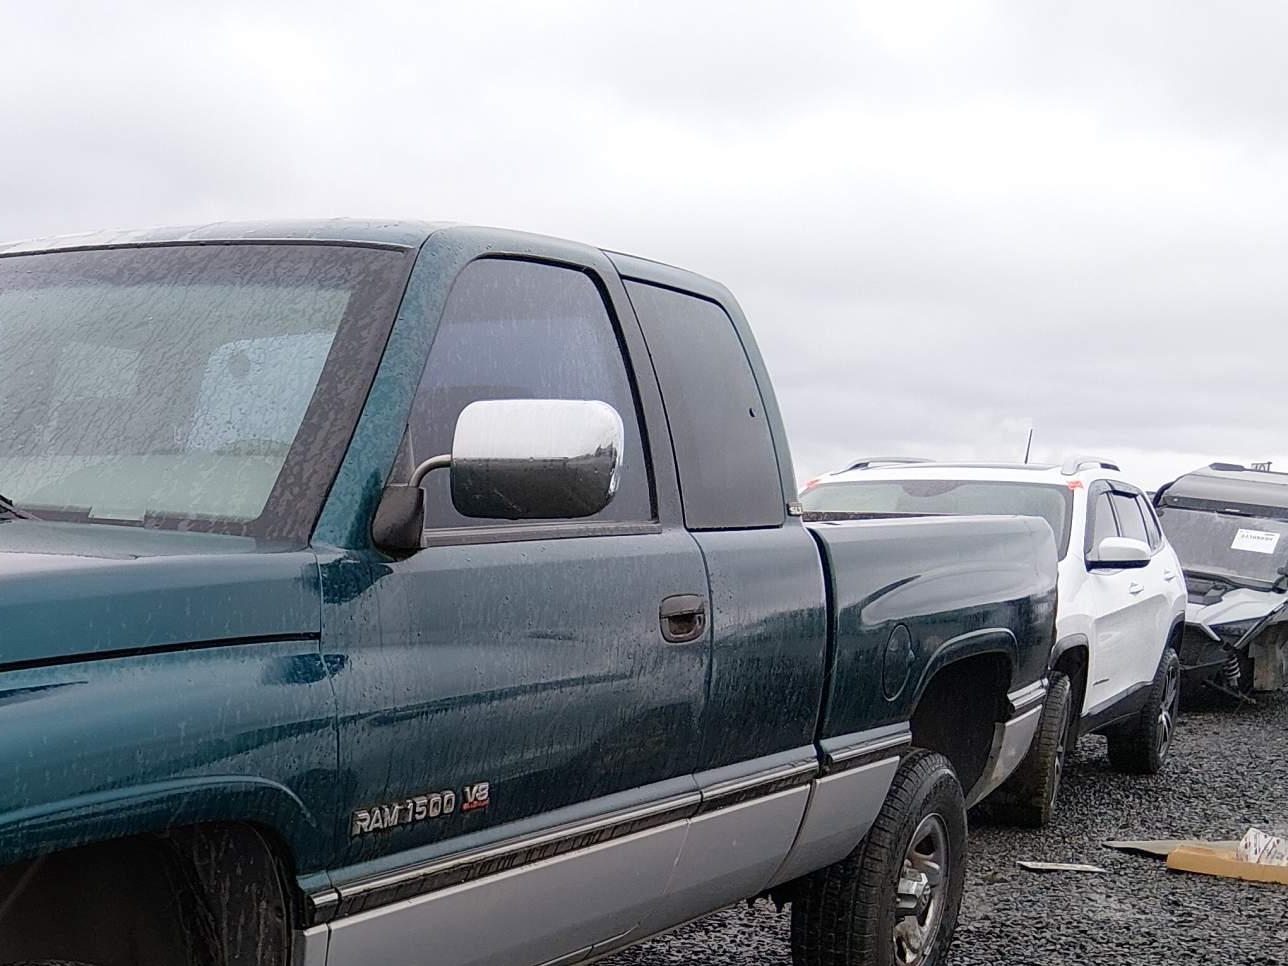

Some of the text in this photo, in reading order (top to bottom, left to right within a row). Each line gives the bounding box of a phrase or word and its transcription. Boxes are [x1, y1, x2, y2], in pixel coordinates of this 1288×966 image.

[352, 782, 489, 835] RAM 1500 V8
